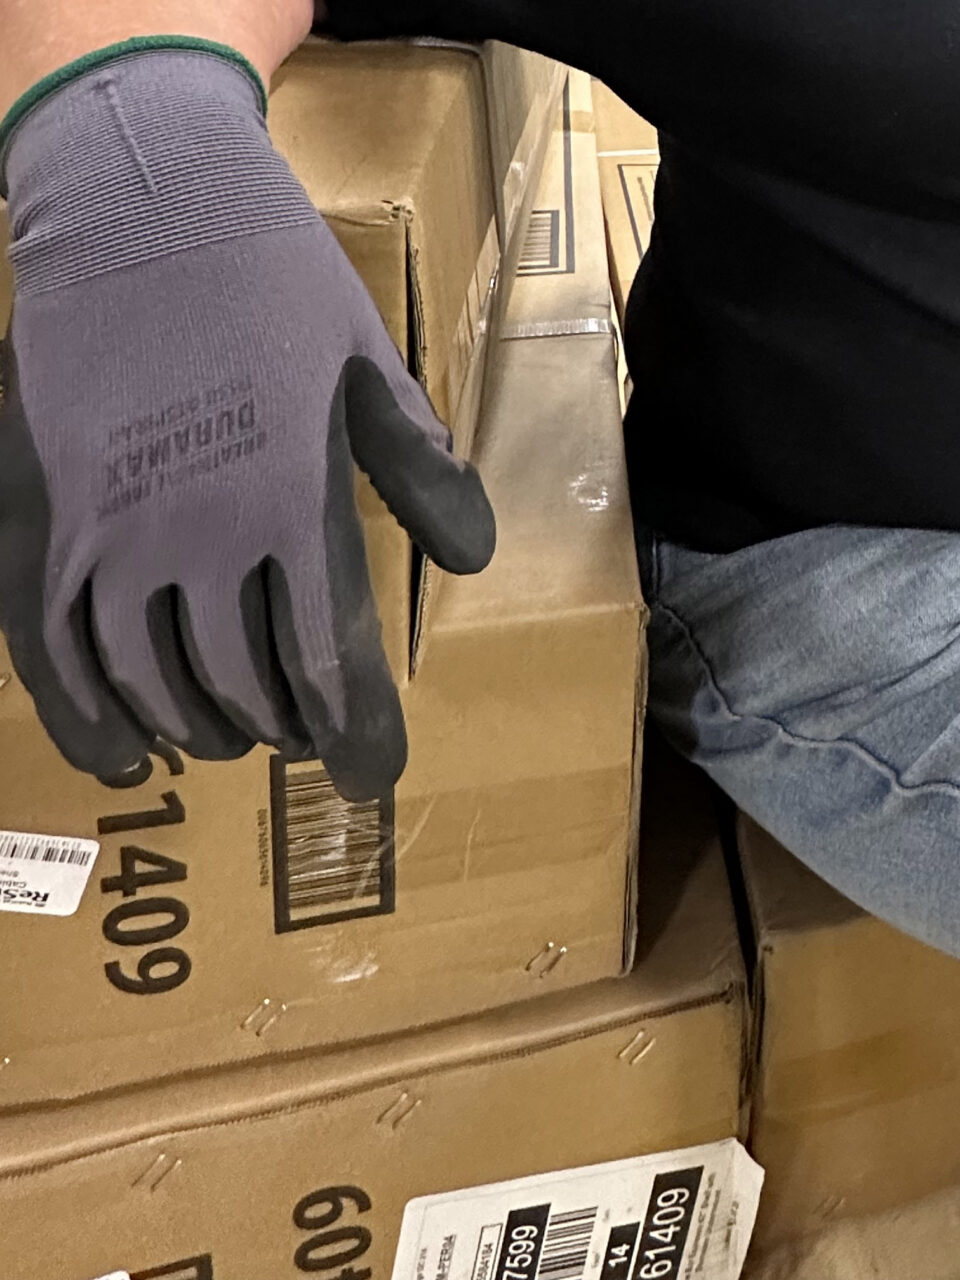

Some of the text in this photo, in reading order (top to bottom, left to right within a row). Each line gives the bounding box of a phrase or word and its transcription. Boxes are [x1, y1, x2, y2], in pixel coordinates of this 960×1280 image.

[0, 888, 50, 903] ReS
[502, 1224, 538, 1280] 7599
[639, 1187, 691, 1280] 61409
[608, 1243, 631, 1268] 14
